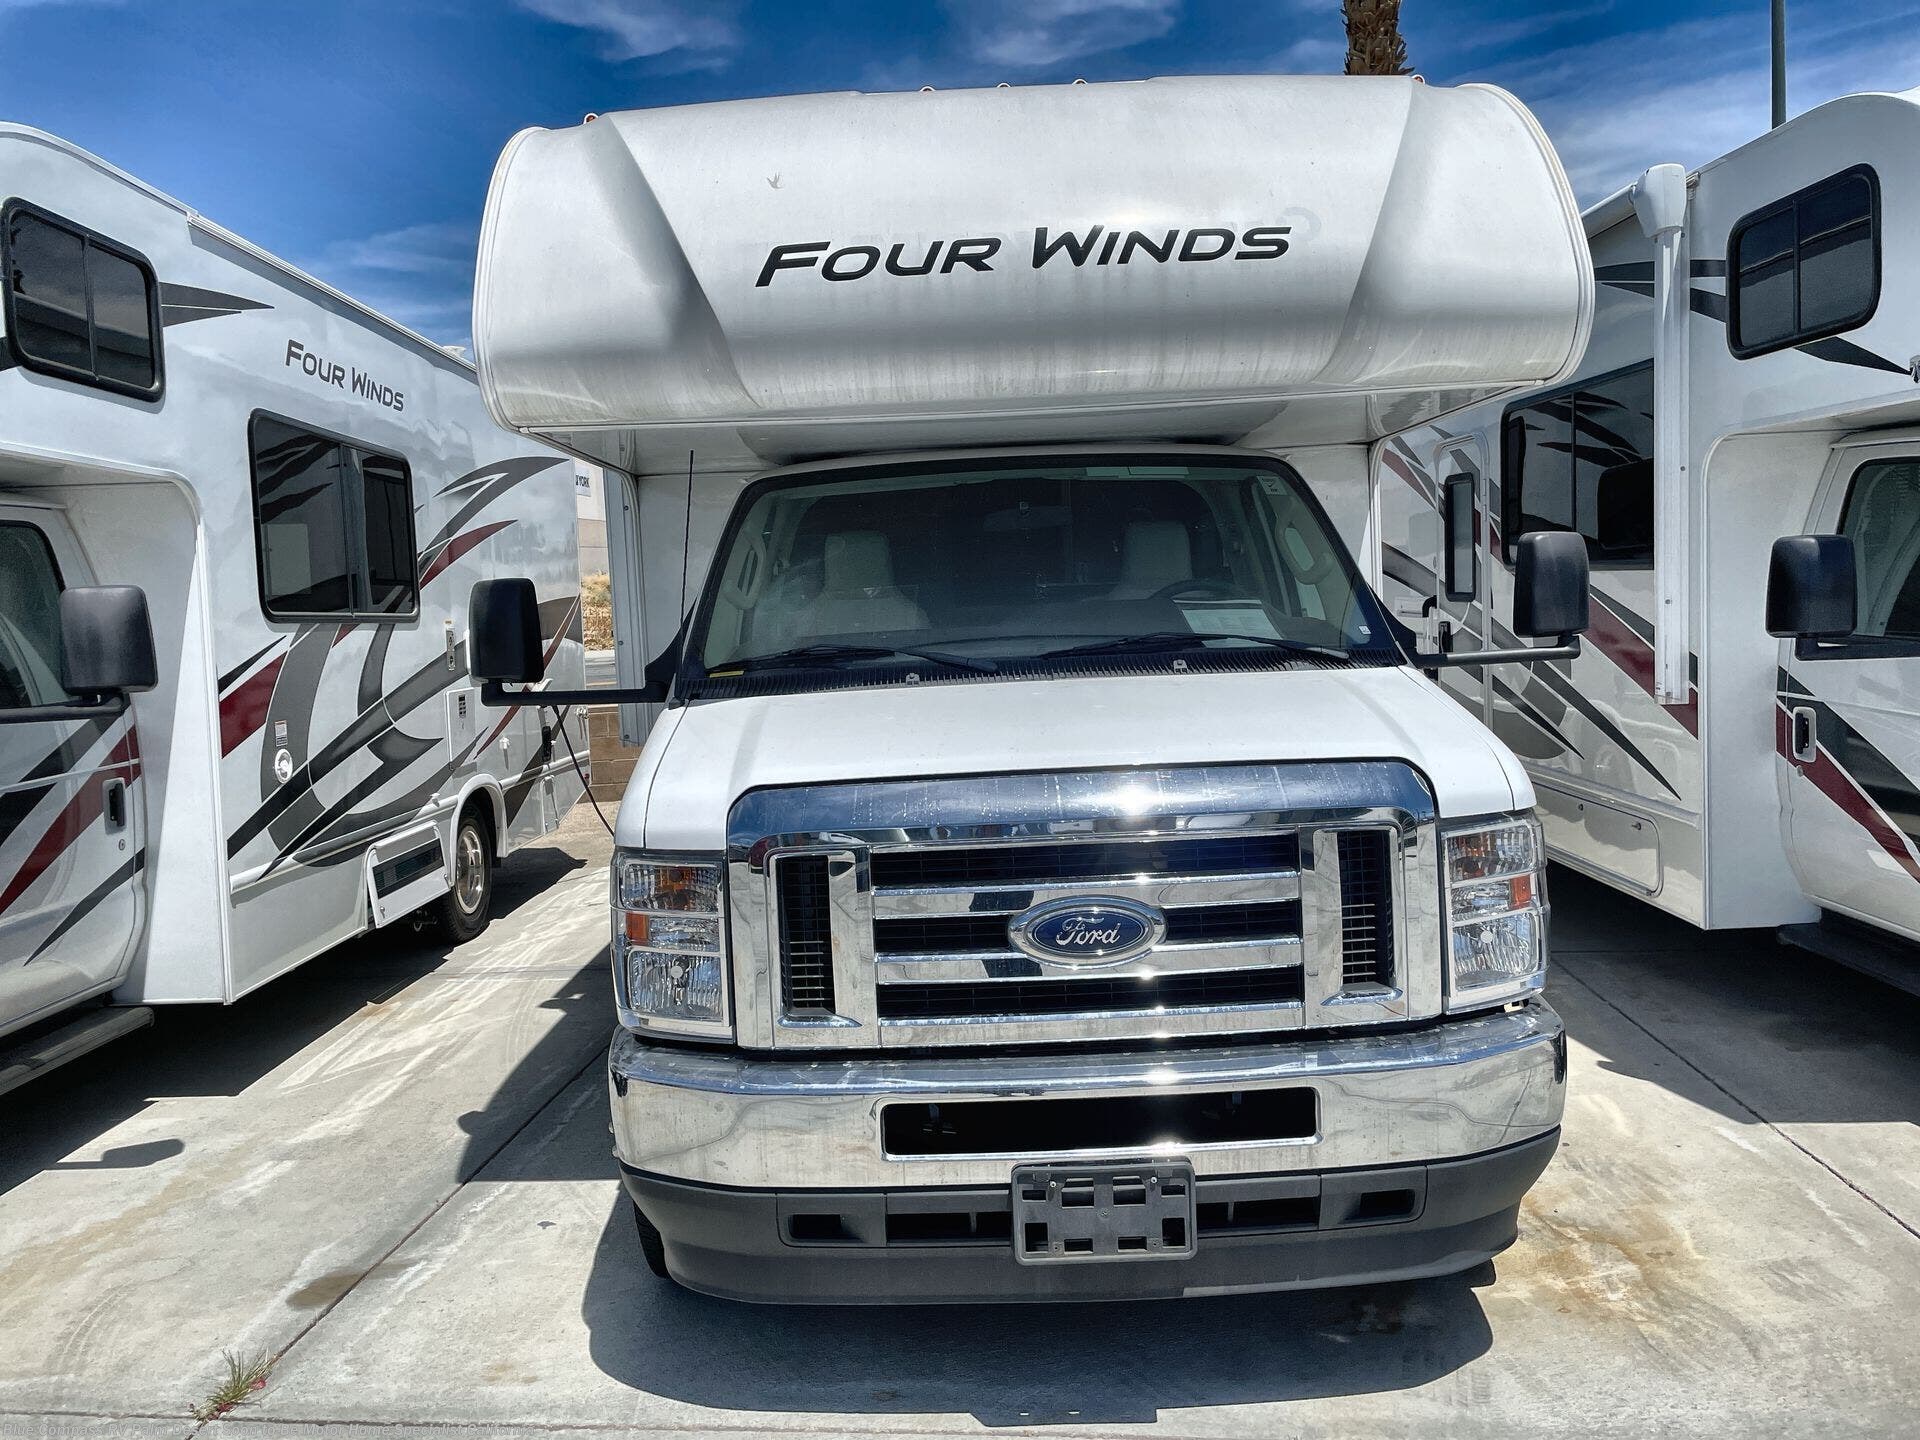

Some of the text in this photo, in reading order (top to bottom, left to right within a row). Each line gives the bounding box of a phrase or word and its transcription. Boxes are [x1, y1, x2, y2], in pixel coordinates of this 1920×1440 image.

[754, 224, 1293, 288] FOUR WINDS
[285, 339, 404, 412] FOUR WINDS
[1056, 917, 1121, 945] Ford
